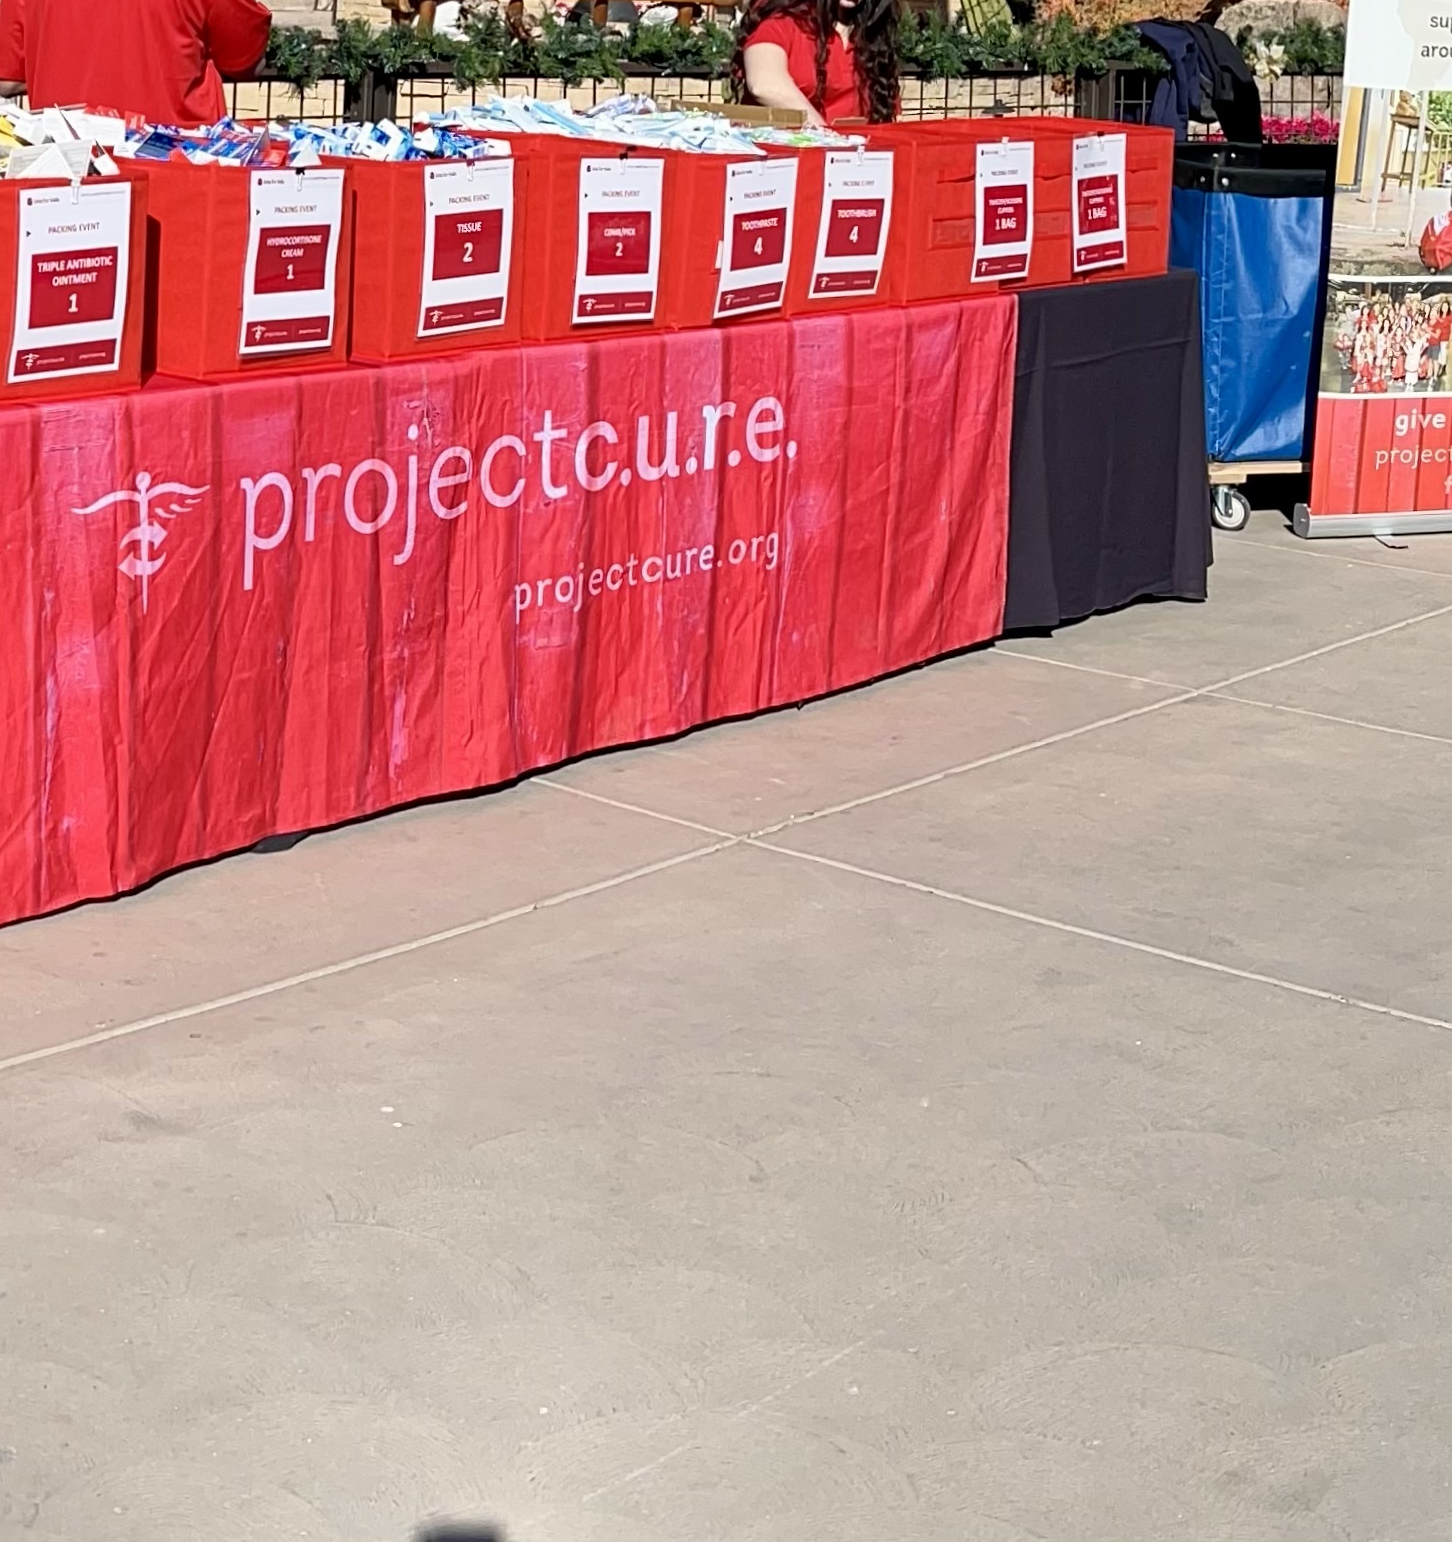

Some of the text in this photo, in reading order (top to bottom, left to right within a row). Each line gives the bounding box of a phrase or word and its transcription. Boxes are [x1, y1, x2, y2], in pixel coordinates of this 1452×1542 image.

[448, 195, 472, 204] PACKING
[274, 205, 318, 214] PACKING EVENT
[1087, 206, 1108, 220] 1 BAG
[48, 222, 101, 235] PACKING EVENT
[456, 221, 483, 233] TISSUE
[741, 217, 779, 231] TOOTHPASTE
[995, 217, 1017, 231] 1 BAG
[848, 225, 859, 244] 4
[281, 247, 305, 258] CREAM
[462, 241, 474, 263] 2
[615, 242, 624, 257] 2
[753, 237, 763, 255] 4
[37, 255, 114, 273] TRIPLE ANTIBIOTIC
[51, 272, 98, 287] OINTMENT
[286, 264, 295, 280] 1
[67, 293, 79, 313] 1
[1395, 407, 1446, 437] give
[240, 395, 799, 592] projectc.u.r.e.
[513, 530, 782, 624] projectcure.org
